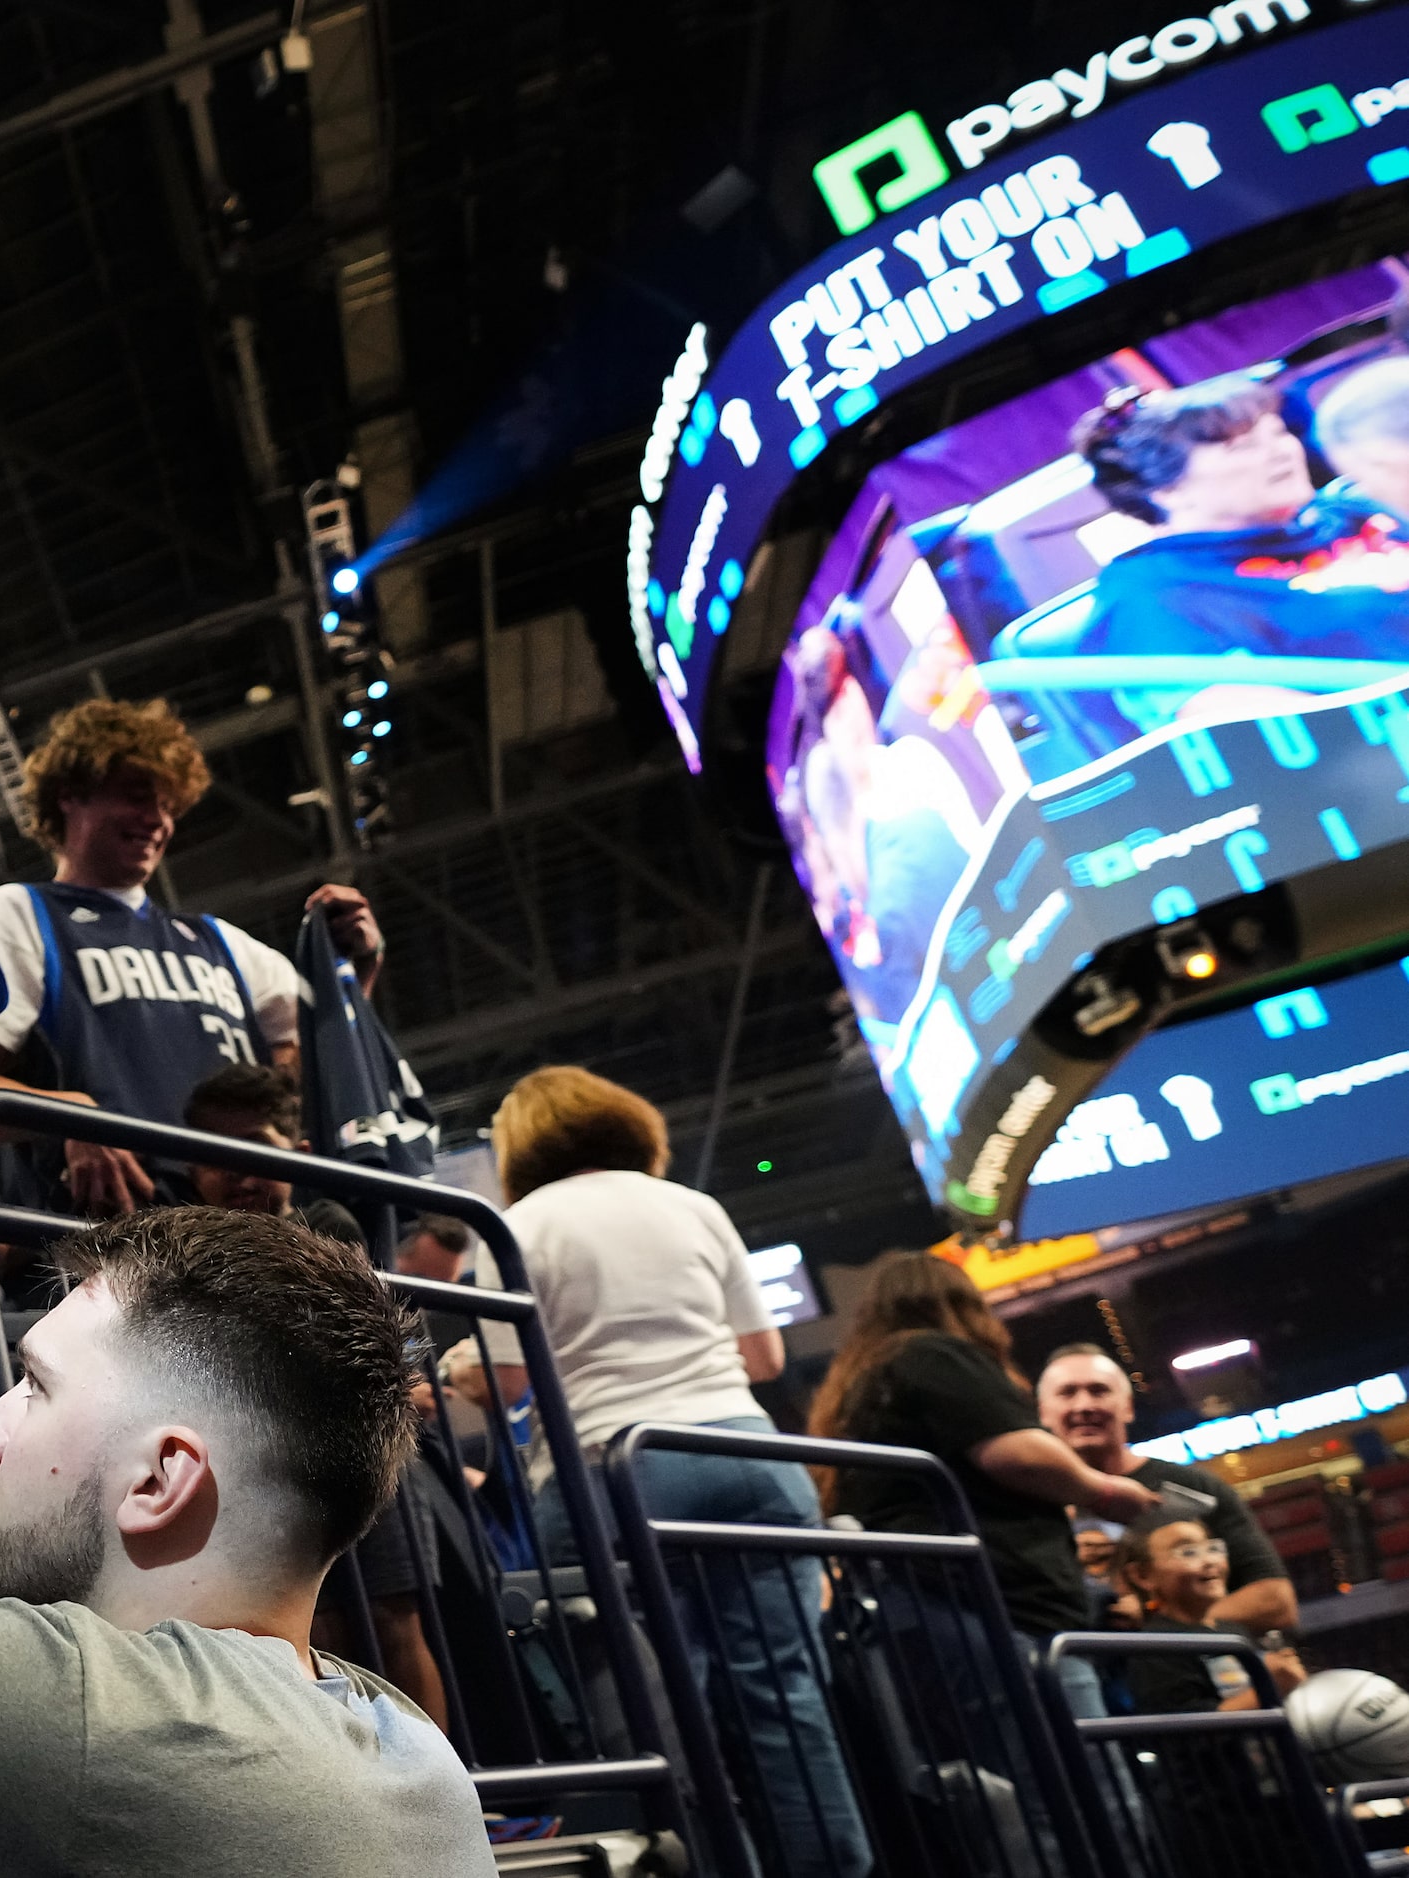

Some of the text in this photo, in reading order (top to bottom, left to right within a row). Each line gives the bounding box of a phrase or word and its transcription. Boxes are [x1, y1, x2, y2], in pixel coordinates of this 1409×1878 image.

[945, 0, 1311, 169] paycom
[769, 154, 1097, 369] PUT YOUR
[776, 241, 1024, 428] T-SHIRT
[1031, 191, 1146, 279] ON
[76, 945, 246, 1021] DALLAS
